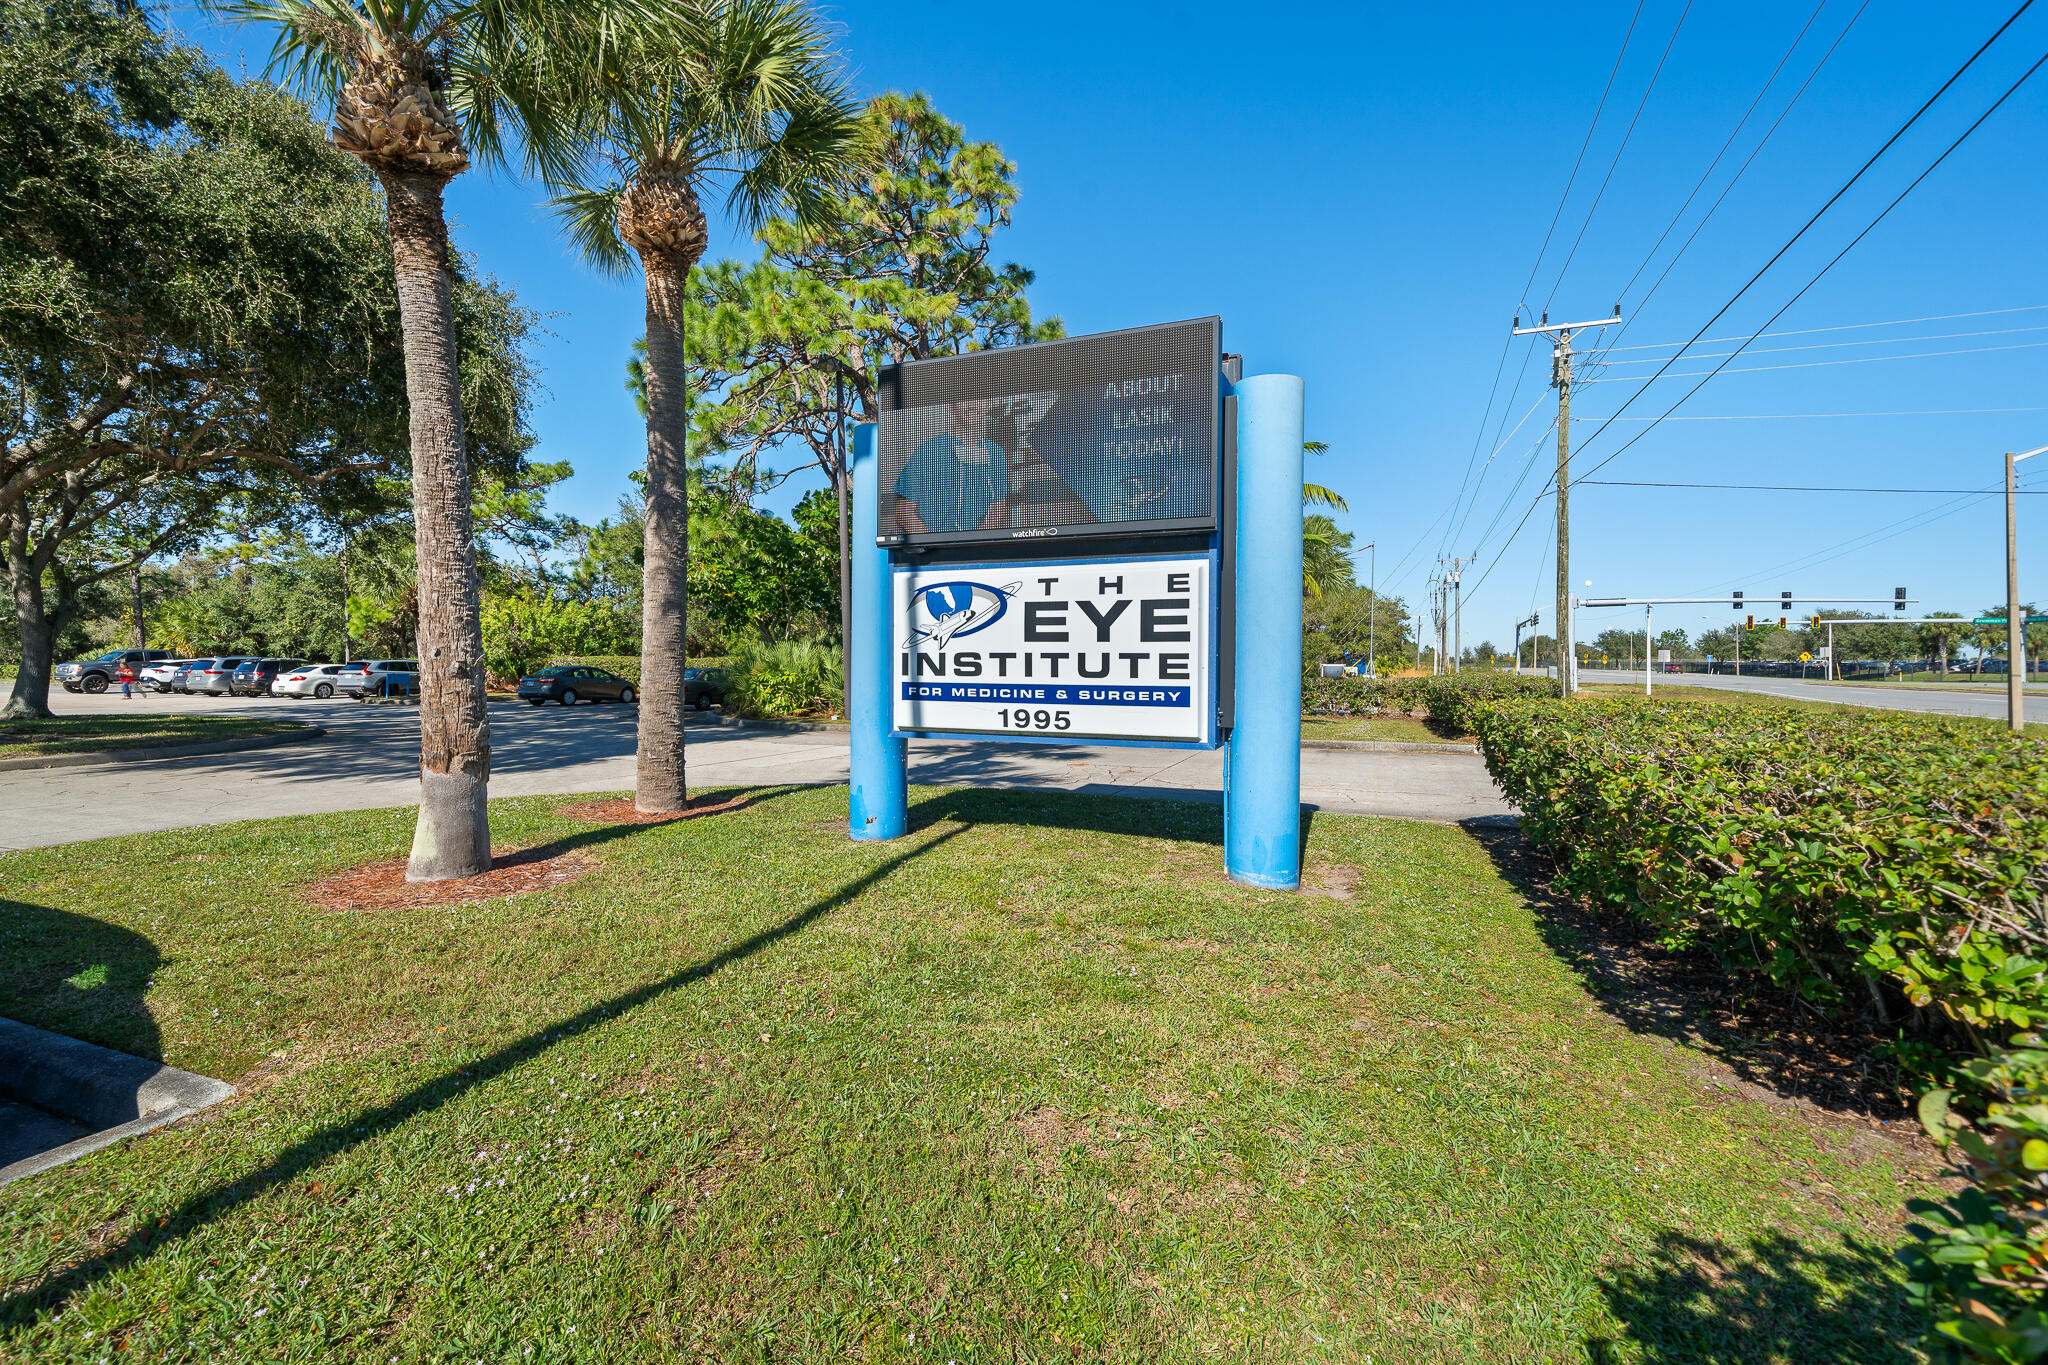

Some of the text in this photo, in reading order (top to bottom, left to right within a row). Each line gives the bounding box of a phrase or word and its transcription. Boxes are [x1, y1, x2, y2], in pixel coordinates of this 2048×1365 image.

[1104, 375, 1182, 399] ABOUT
[1113, 406, 1174, 428] LASIK
[1103, 437, 1183, 458] TODAY!
[1012, 528, 1045, 538] watchfire
[1037, 573, 1190, 596] THE
[1024, 598, 1191, 642] EYE
[901, 652, 1190, 680] INSTITUTE
[908, 686, 1182, 702] FOR MEDICINE & SURGERY
[997, 708, 1071, 731] 1995
